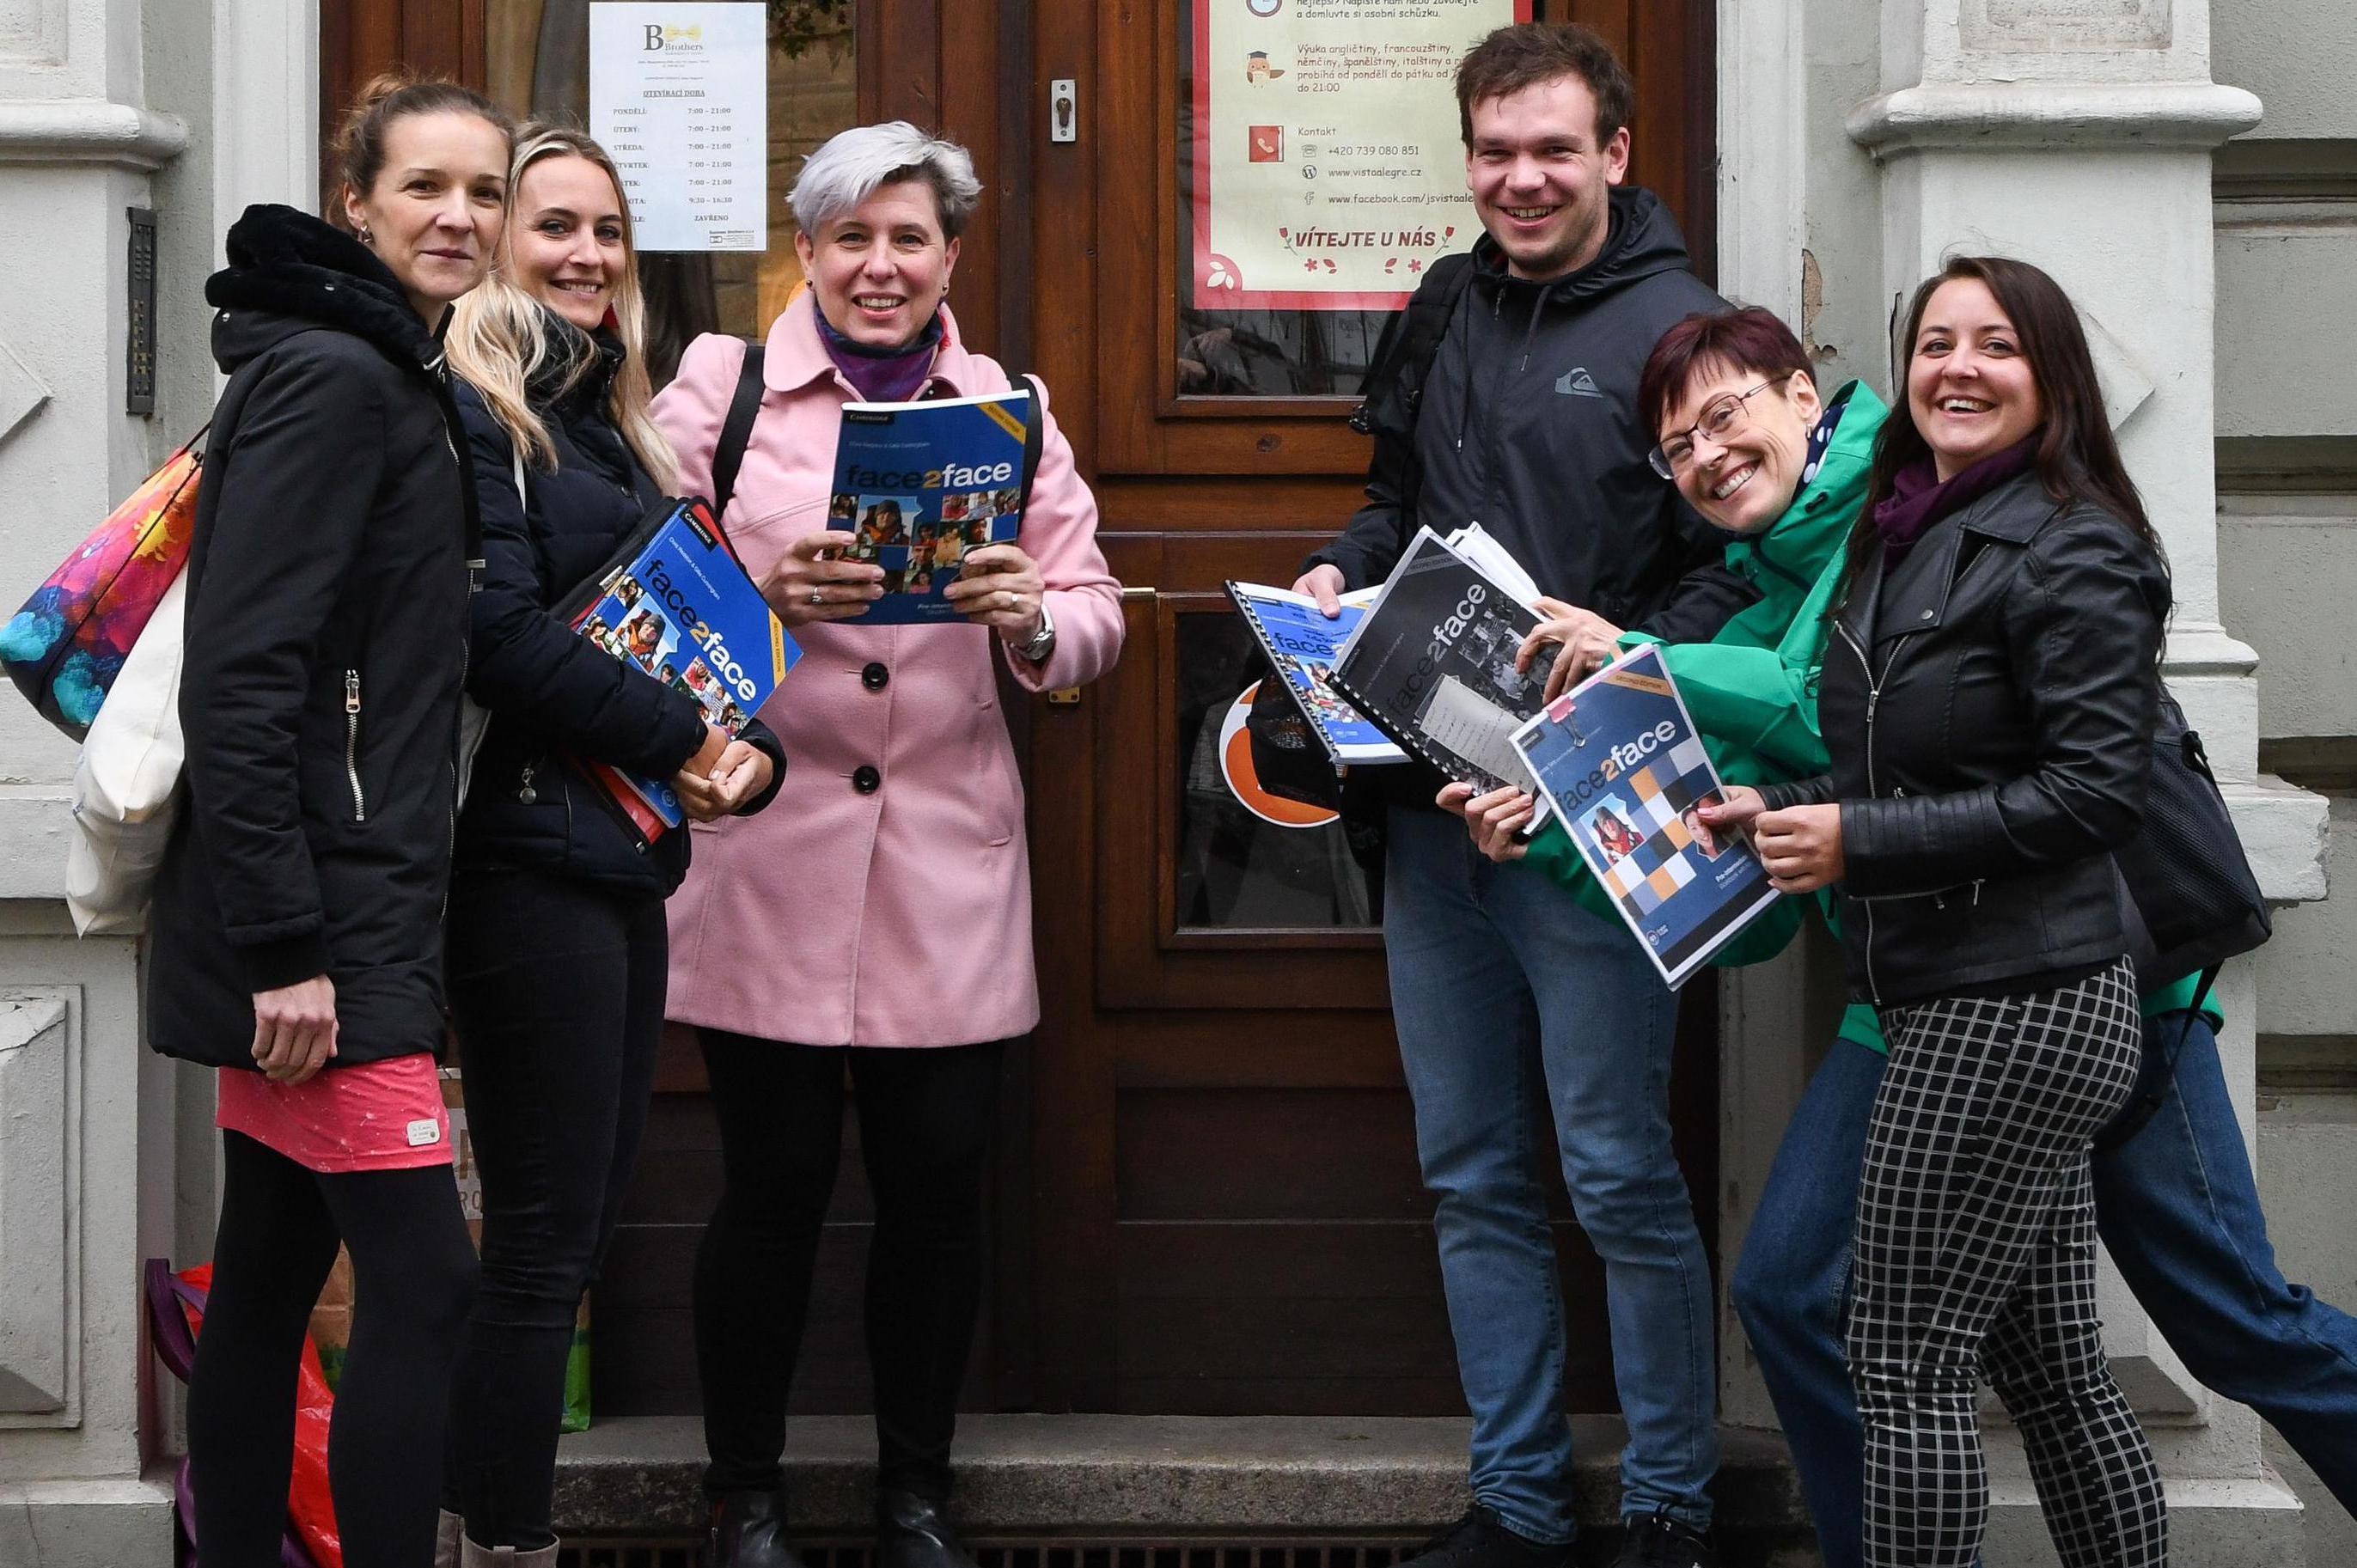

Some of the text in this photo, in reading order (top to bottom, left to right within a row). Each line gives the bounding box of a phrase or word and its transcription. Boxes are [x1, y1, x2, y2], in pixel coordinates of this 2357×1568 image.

[1305, 9, 1350, 18] domluvte
[1353, 9, 1361, 18] si
[1365, 9, 1395, 18] osobní
[1399, 7, 1441, 18] schůzku.
[643, 24, 664, 51] B
[665, 42, 704, 51] Brothers
[1298, 44, 1327, 56] Výuka
[1384, 43, 1454, 55] francouzštiny,
[1297, 57, 1340, 69] němčiny,
[1402, 56, 1442, 68] italštiny
[1298, 69, 1334, 82] probíhá
[1337, 70, 1350, 79] od
[1353, 69, 1388, 82] pondělí
[1390, 70, 1402, 79] do
[1406, 69, 1433, 82] pátku
[1436, 69, 1449, 78] od
[1298, 82, 1340, 92] do 21:00
[1298, 127, 1336, 136] Kontakt
[1328, 145, 1419, 156] +420 739 080 851
[1328, 166, 1421, 179] www.vistaalegre.cz
[1328, 192, 1474, 205] www.facebook.com/jsvistaale
[1295, 225, 1436, 247] VÍTEJTE U NÁS
[846, 461, 1012, 490] face2face
[645, 559, 756, 701] face2face
[1387, 583, 1487, 717] face2face
[1555, 719, 1676, 815] face2face
